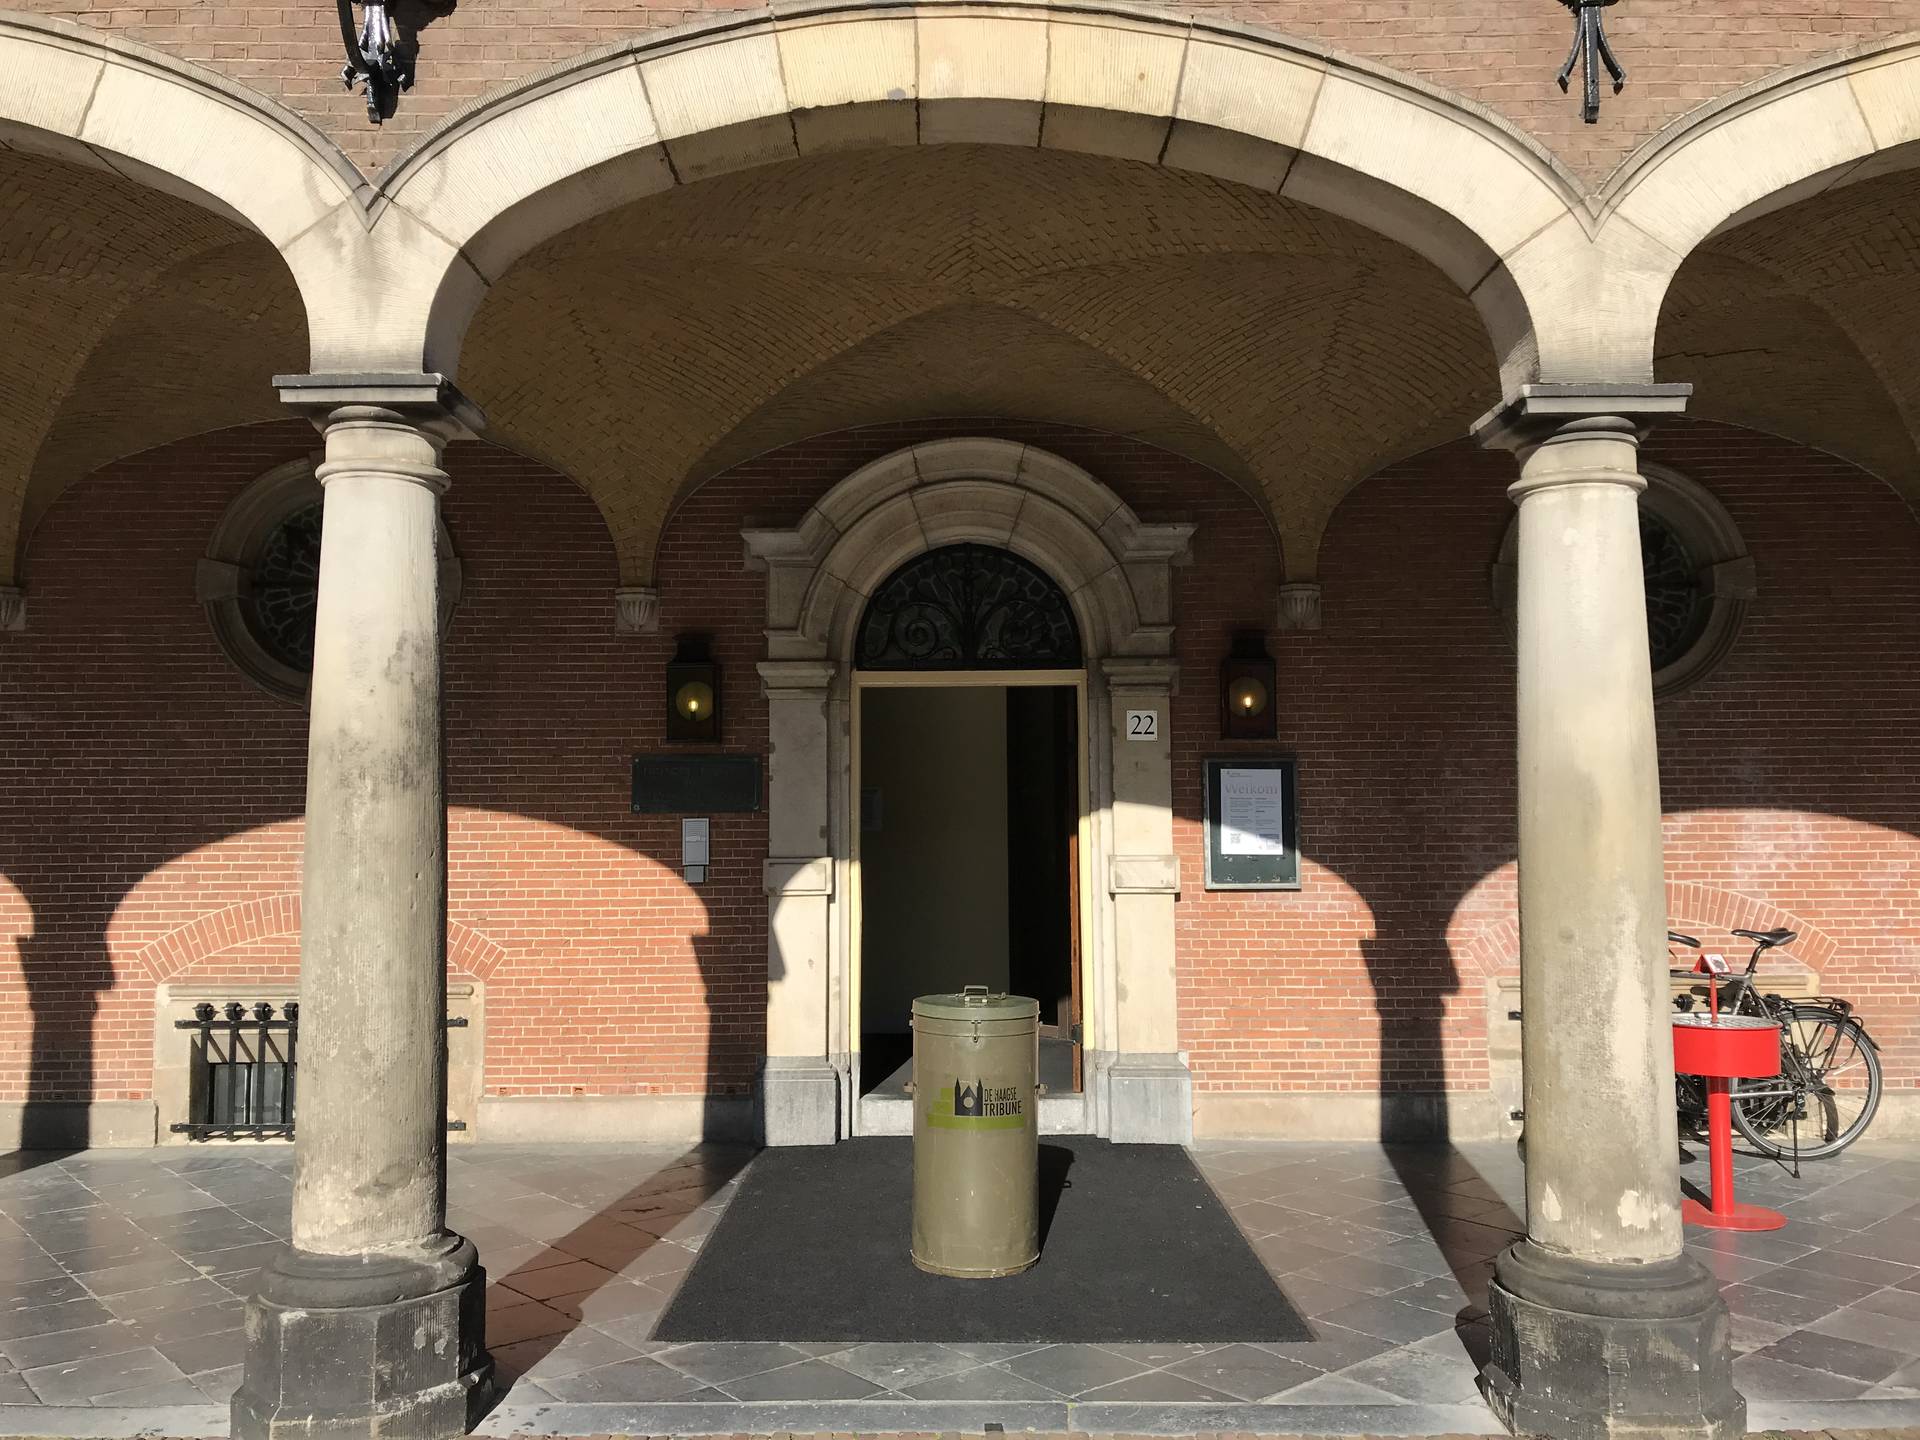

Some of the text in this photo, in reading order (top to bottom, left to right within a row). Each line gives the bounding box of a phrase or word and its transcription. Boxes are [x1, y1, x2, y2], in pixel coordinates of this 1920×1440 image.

[1130, 715, 1155, 735] 22
[1225, 783, 1278, 794] Welkom
[984, 1087, 1017, 1102] DE HAAGSE
[984, 1101, 1022, 1116] TRIBUNE
